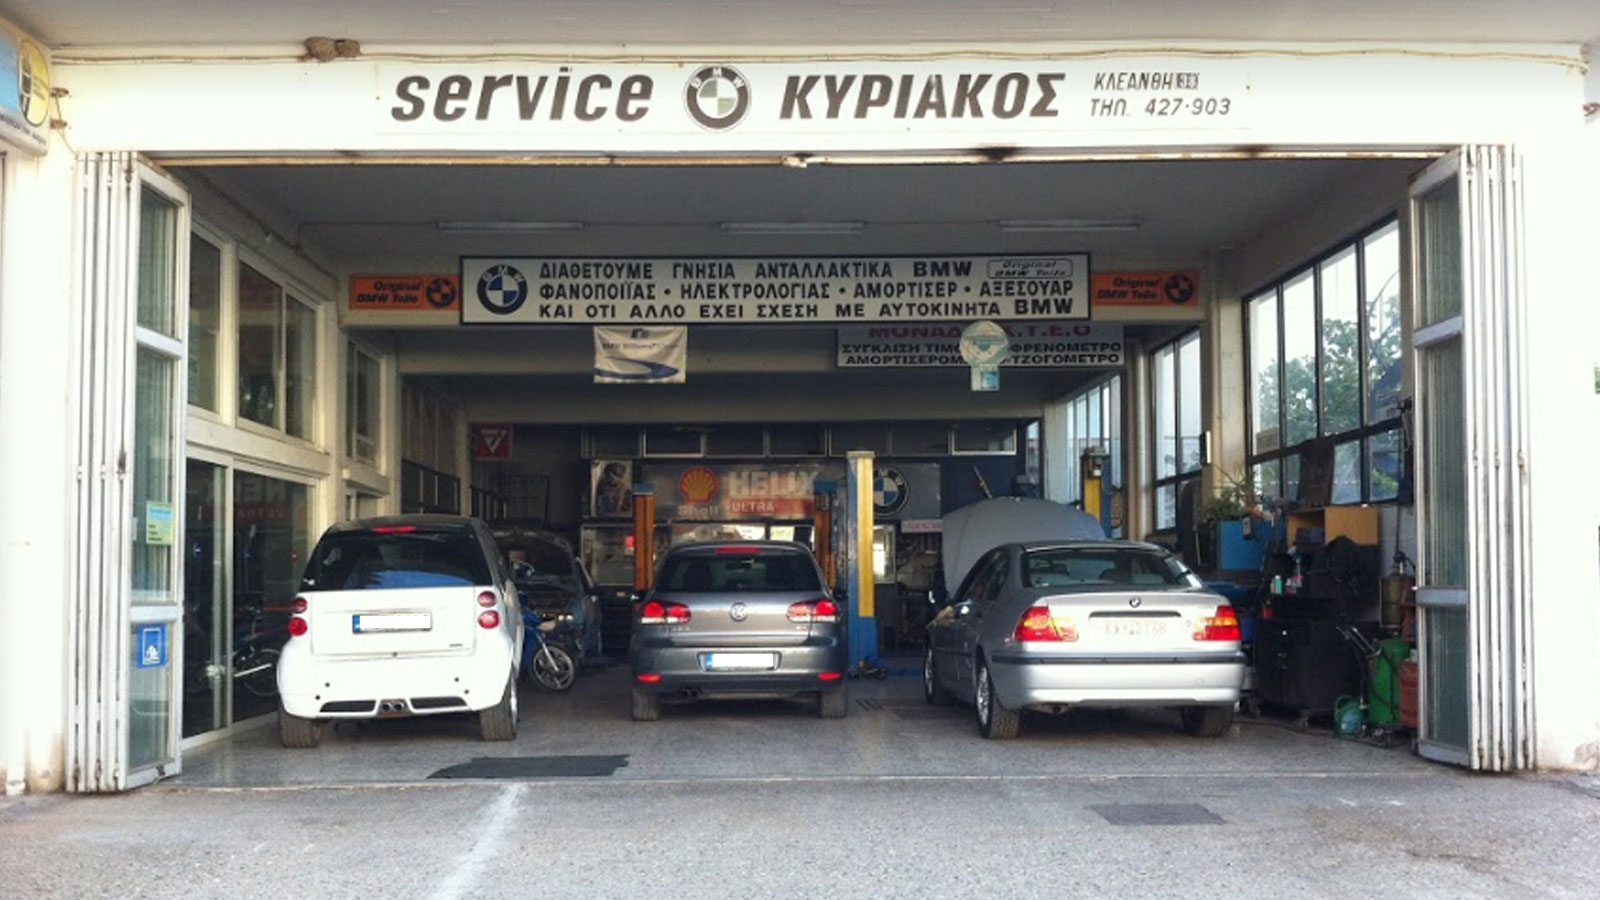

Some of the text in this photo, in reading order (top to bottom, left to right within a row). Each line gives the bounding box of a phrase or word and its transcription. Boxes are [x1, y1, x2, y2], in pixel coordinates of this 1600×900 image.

[1093, 72, 1174, 90] ΚΛΕΑΝΘΗ
[391, 66, 654, 122] service
[779, 71, 1066, 119] ΚΥΡΙΑΚΟΣ
[539, 261, 972, 279] ΔΙΑΘΕΤΟΥΜΕ ΓΝΗΣΙΑ ΑΝΤΑΛΛΑΚΤΙΚΑ BMW
[681, 282, 830, 300] ΗΛΕΚΤΡΟΛΟΓΙΑΣ
[853, 281, 958, 298] ΑΜΟΡΤΙΣΕΡ
[979, 280, 1074, 297] ΑΞΕΣΟΥΑΡ
[539, 298, 1074, 319] ΚΑΙ ΟΤΙ ΑΛΛΟ ΕΧΕΙ ΣΧΕΣΗ ΜΕ ΑΥΤΟΚΙΝΗΤΑ BMW
[869, 327, 961, 337] ΜΟΝΑΔ
